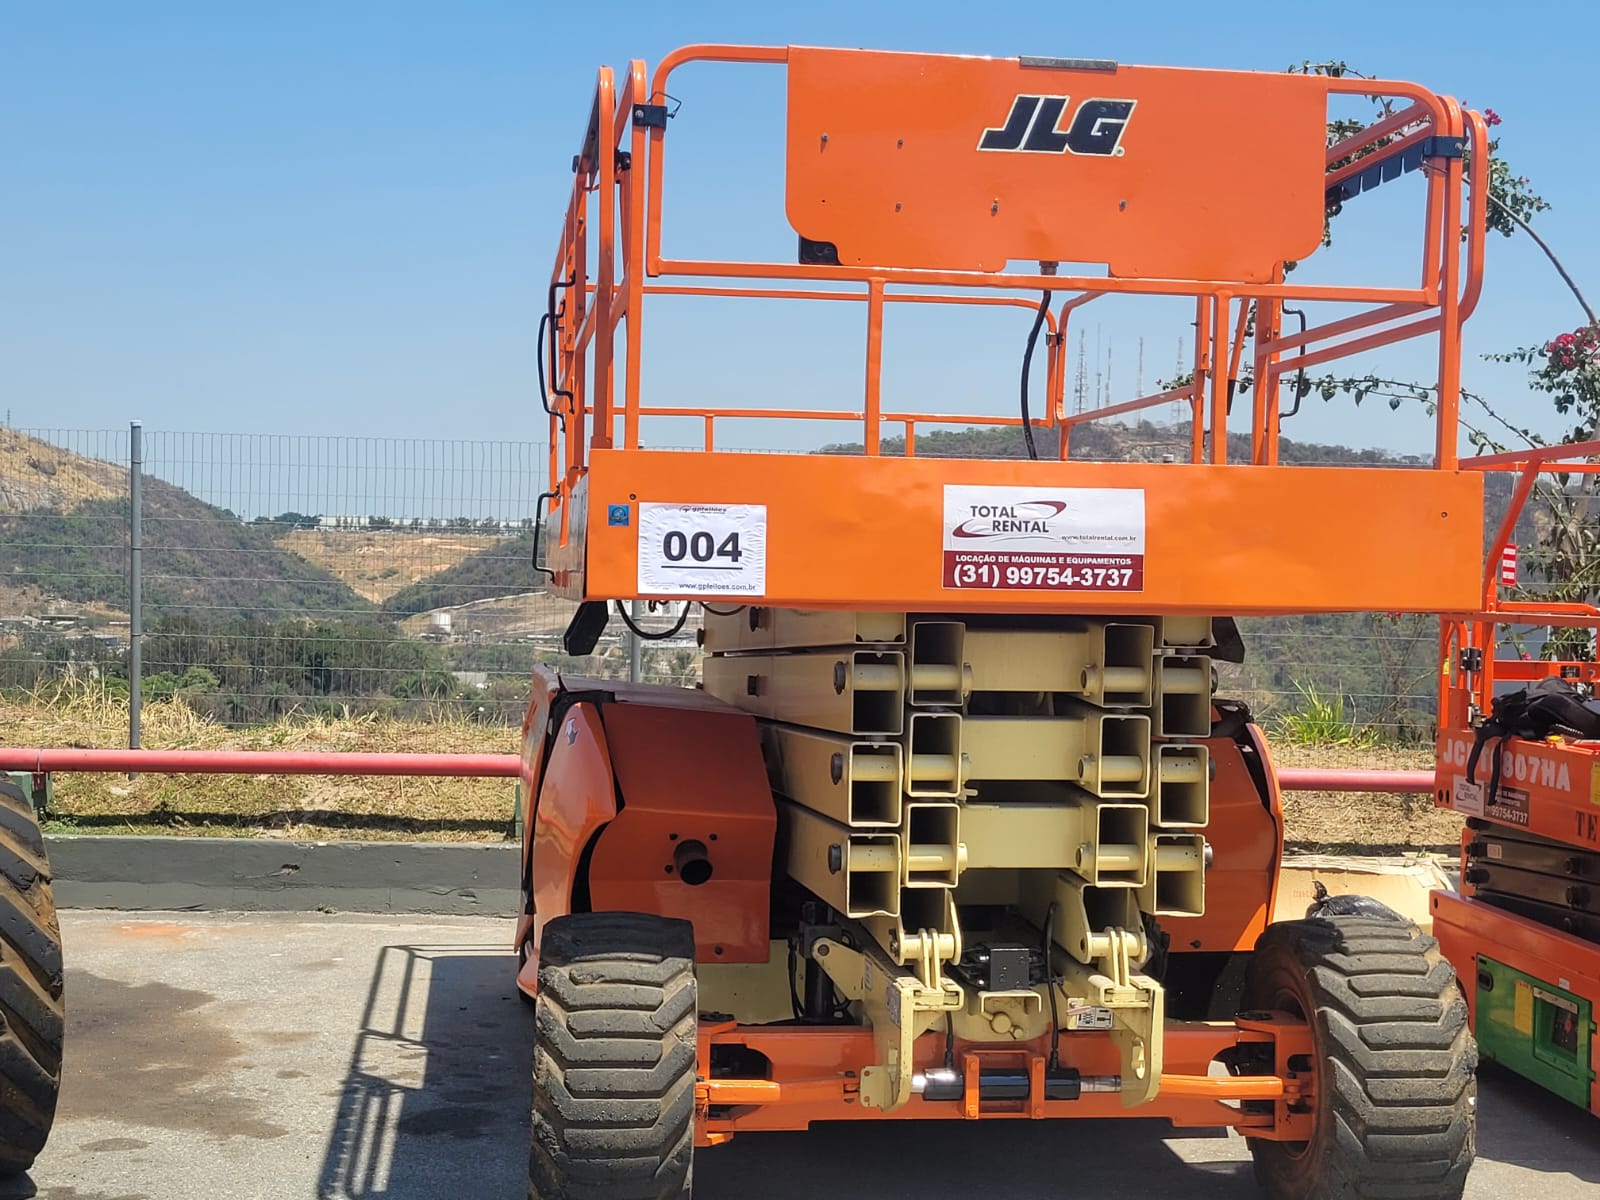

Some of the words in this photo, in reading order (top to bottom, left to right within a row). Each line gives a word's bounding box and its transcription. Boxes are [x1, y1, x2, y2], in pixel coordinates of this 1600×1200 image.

[976, 94, 1138, 157] JLG
[970, 504, 1018, 519] TOTAL
[992, 519, 1050, 533] RENTAL
[663, 530, 742, 563] 004
[956, 554, 996, 564] LOCAÇÃO
[998, 555, 1009, 563] DE
[1011, 555, 1057, 564] MÁQUINAS
[1059, 557, 1065, 565] E
[1066, 557, 1132, 566] EQUIPAMENTOS
[953, 564, 1000, 587] (31)
[1006, 566, 1133, 587] 99754-3737
